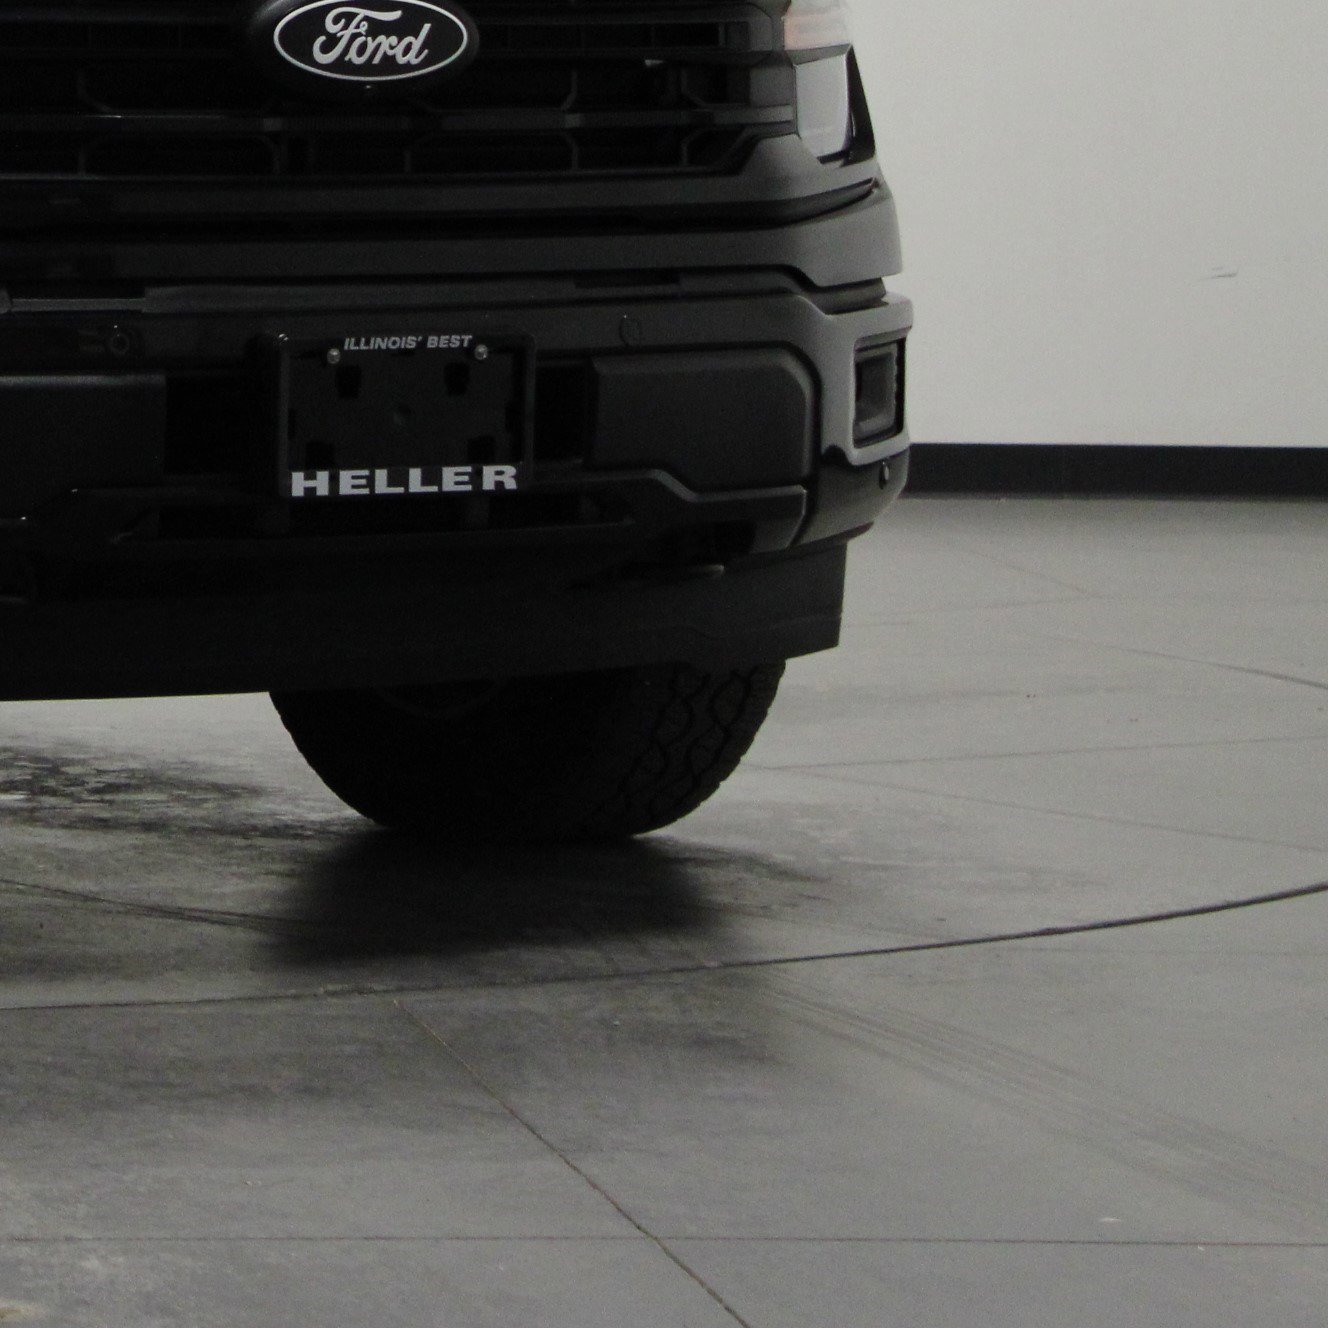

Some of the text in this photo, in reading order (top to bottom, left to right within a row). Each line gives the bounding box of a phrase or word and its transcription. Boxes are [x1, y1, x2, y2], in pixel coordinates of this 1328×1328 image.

[312, 6, 432, 65] Ford
[344, 335, 472, 351] ILLINOIS' BEST
[291, 465, 517, 497] HELLER
